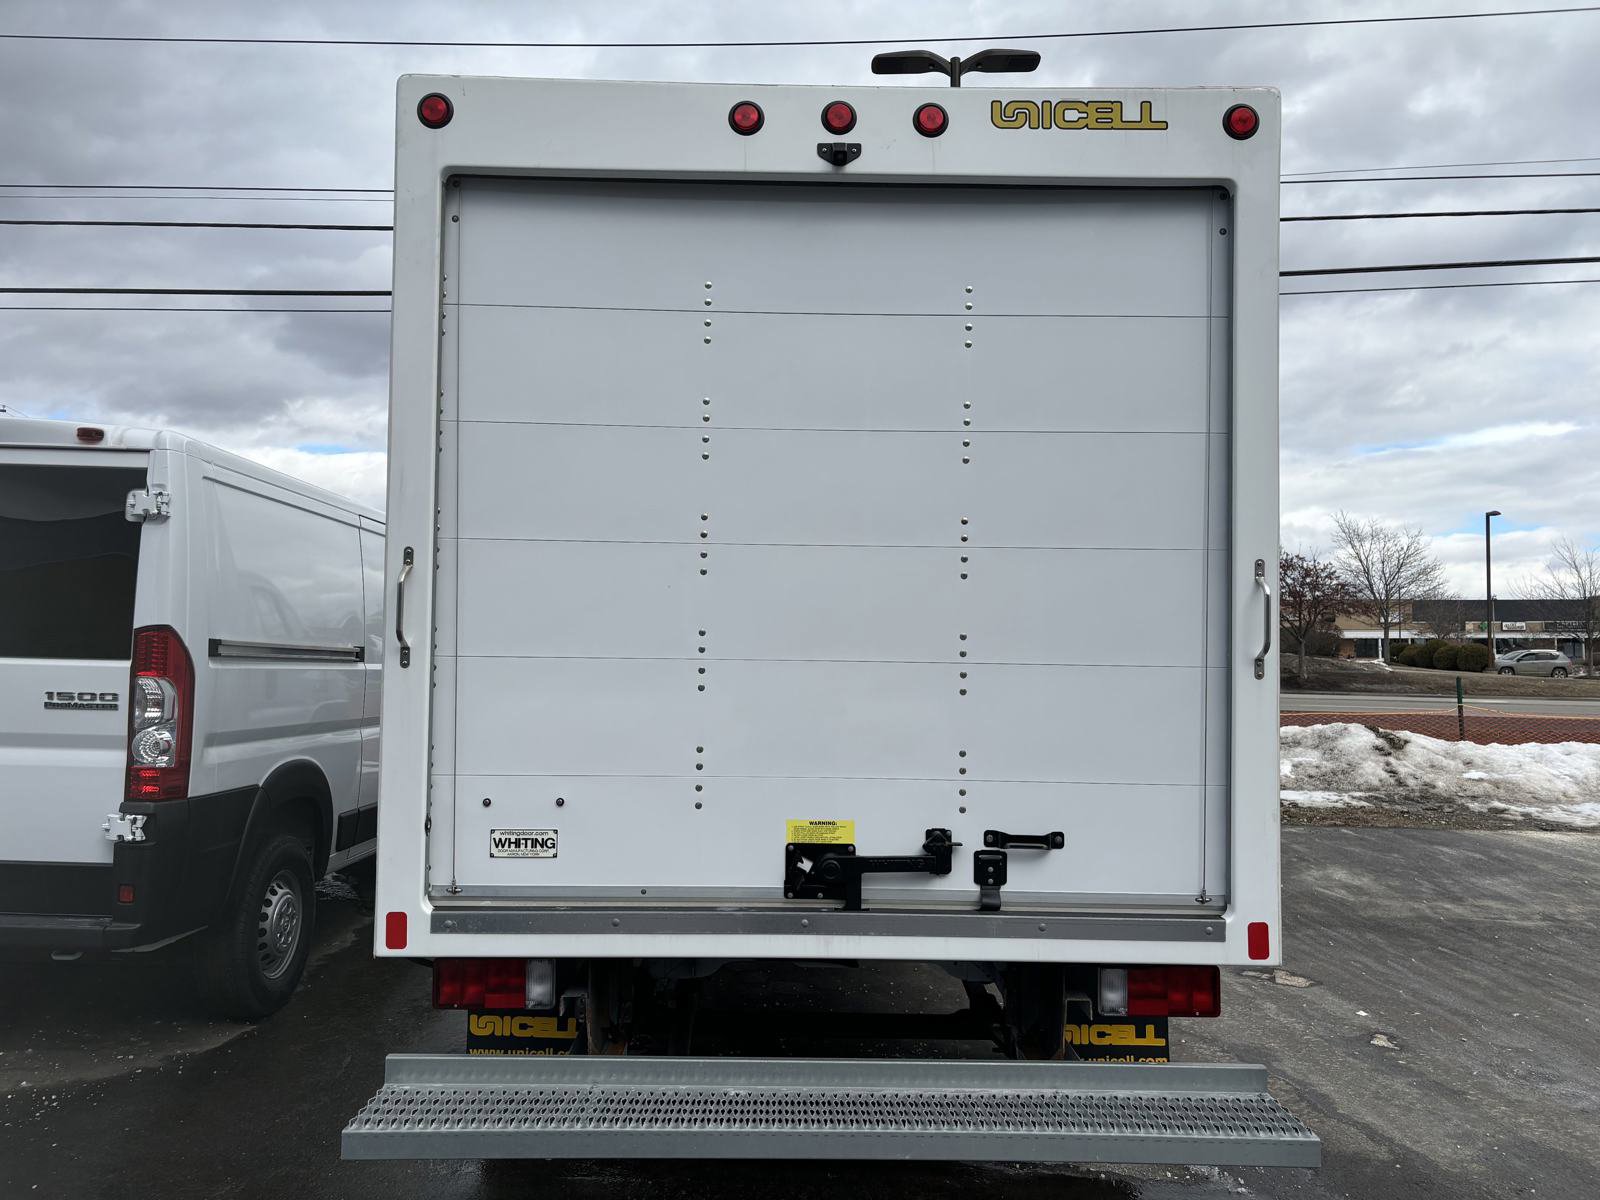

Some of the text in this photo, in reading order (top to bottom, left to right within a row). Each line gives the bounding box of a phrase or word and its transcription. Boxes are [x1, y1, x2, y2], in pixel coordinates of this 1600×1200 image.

[991, 100, 1168, 130] UNICELL
[44, 691, 119, 702] 1500
[493, 837, 556, 849] WHITING
[1064, 1024, 1166, 1046] NICELL
[469, 1048, 571, 1056] wwwunicellc
